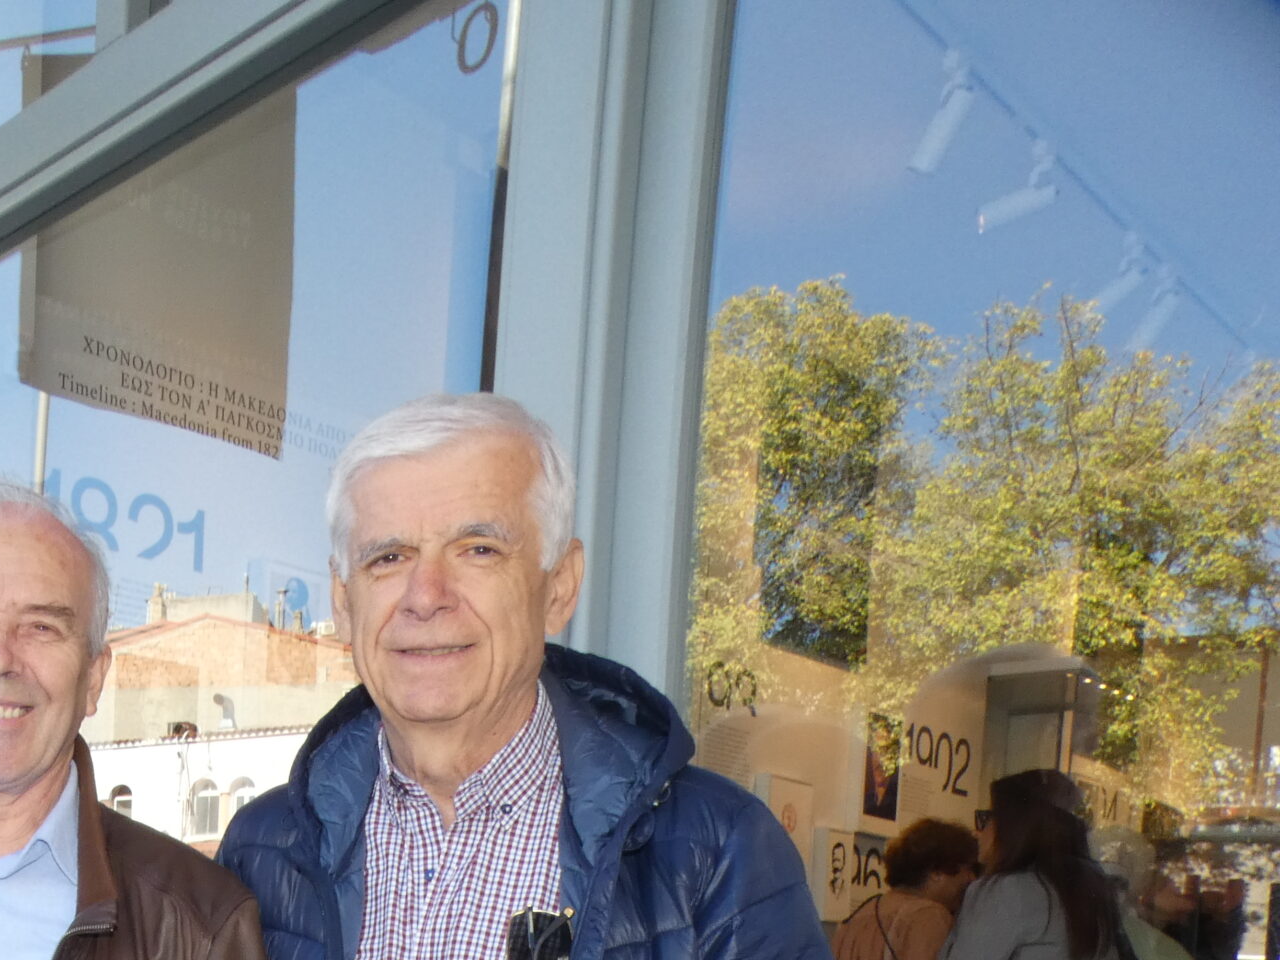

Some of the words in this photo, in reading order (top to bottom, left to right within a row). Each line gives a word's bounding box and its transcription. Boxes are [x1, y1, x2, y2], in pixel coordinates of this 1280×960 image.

[83, 335, 195, 390] ΧΡΟΝΟΛΟΓΙΟ
[58, 371, 127, 410] Timeline
[141, 400, 217, 439] Macedonia
[222, 427, 253, 450] from
[121, 371, 153, 397] ΕΩΣ
[158, 384, 192, 410] ΤΟΝ
